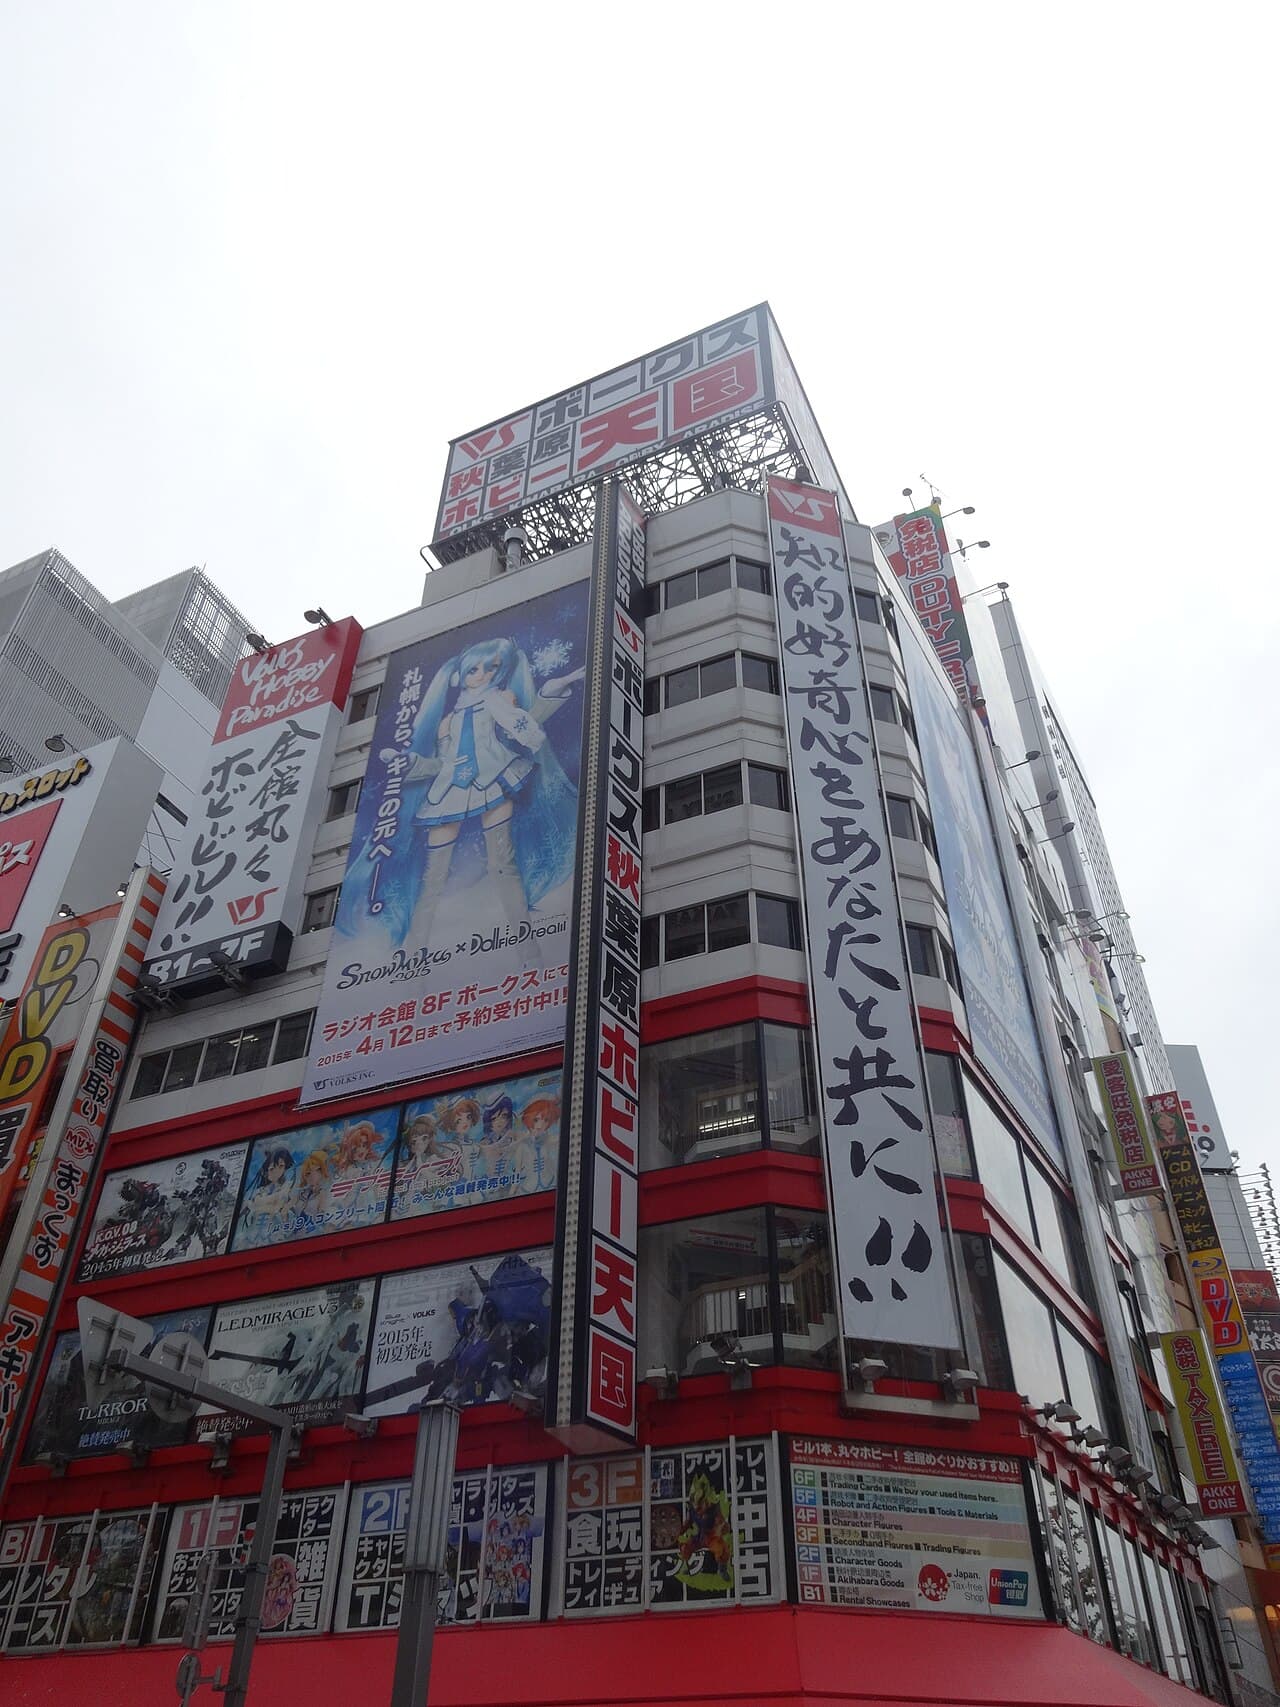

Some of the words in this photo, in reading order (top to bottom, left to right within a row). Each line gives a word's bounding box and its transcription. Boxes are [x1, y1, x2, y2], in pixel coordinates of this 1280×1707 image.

[538, 317, 758, 434] ボークス
[449, 425, 572, 498] 秋葉原
[900, 517, 942, 577] 免税店
[911, 577, 954, 641] DUTY
[245, 720, 321, 882] 全館丸々
[0, 928, 90, 1101] DVD
[322, 1000, 417, 1041] ラジオ会館
[421, 991, 453, 1015] 8F
[82, 1040, 120, 1123] 買取り
[1124, 1167, 1153, 1180] AKKY
[1169, 1161, 1192, 1175] CD
[1129, 1177, 1153, 1190] ONE
[35, 1162, 82, 1267] まっくす
[1201, 1276, 1242, 1347] DVD
[378, 1326, 425, 1347] 2015年
[1172, 1337, 1200, 1371] 免税
[1182, 1372, 1213, 1418] TAX
[1193, 1420, 1227, 1482] FREE
[571, 1461, 637, 1506] 3F
[793, 1471, 815, 1487] 6F
[796, 1489, 816, 1504] 5F
[830, 1481, 858, 1492] Trading
[860, 1482, 883, 1493] Cards
[905, 1486, 918, 1497] buy
[921, 1489, 938, 1499] your
[940, 1489, 957, 1499] used
[1202, 1485, 1237, 1498] AKKY
[831, 1499, 854, 1510] Robot
[856, 1502, 871, 1510] and
[872, 1502, 898, 1512] Action
[900, 1503, 928, 1515] Figures
[937, 1507, 956, 1517] Tools
[965, 1510, 999, 1520] Materials
[1208, 1497, 1238, 1510] ONE
[796, 1508, 818, 1522] 4F
[832, 1517, 872, 1528] Character
[873, 1520, 903, 1531] Figures
[190, 1507, 239, 1548] 1F
[567, 1509, 642, 1557] 食玩
[797, 1527, 818, 1542] 3F
[734, 1497, 770, 1596] 中古
[799, 1546, 819, 1561] 2F
[833, 1536, 883, 1547] Secondhand
[885, 1540, 914, 1550] Figures
[923, 1542, 952, 1554] Trading
[952, 1545, 981, 1556] Figures
[835, 1555, 876, 1567] Character
[878, 1558, 903, 1569] Goods
[802, 1566, 820, 1581] 1F
[837, 1575, 879, 1586] Akihabara
[880, 1577, 905, 1588] Goods
[991, 1577, 1028, 1590] UnionPay
[289, 1541, 328, 1631] 雑貨
[566, 1580, 664, 1608] フィギュア
[803, 1586, 821, 1600] B1
[840, 1594, 865, 1605] Rental
[867, 1596, 911, 1608] Showcases
[965, 1592, 985, 1604] Shop
